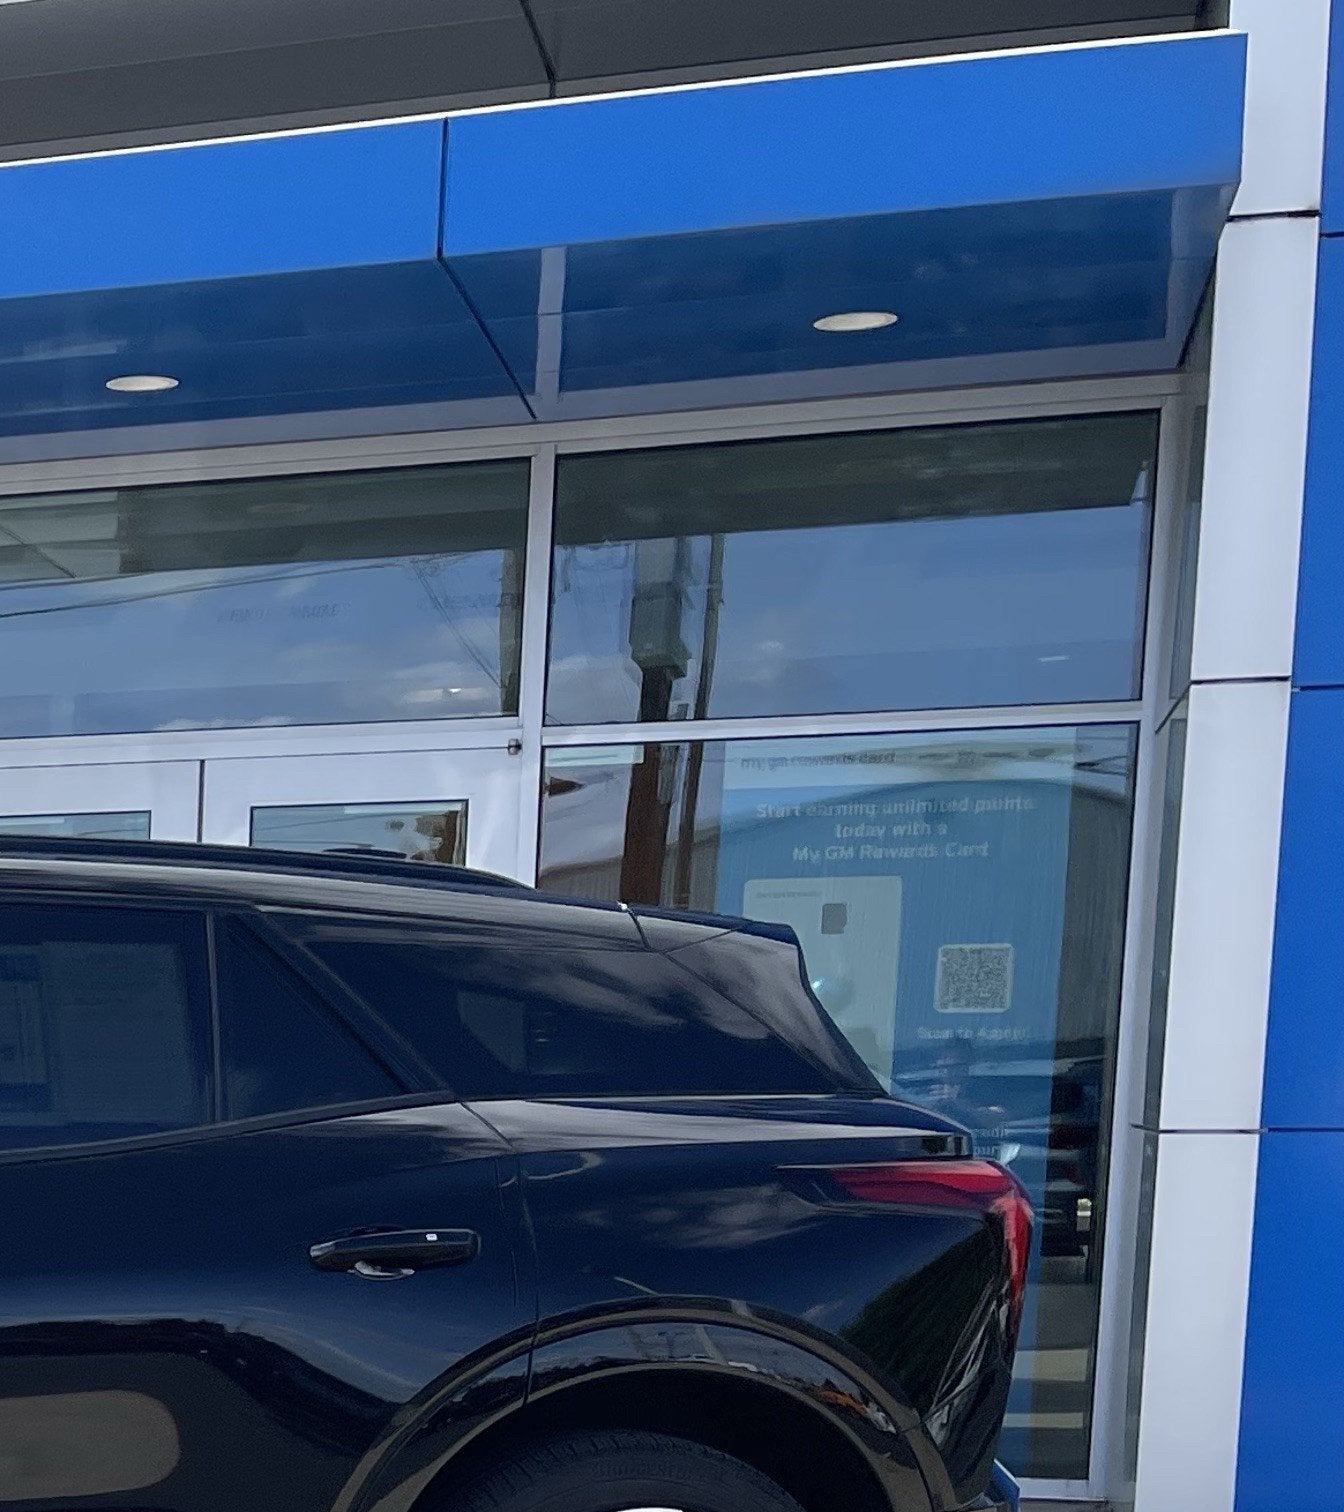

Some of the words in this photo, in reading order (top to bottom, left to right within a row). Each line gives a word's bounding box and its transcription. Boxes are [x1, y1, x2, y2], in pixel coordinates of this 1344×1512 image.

[756, 802, 801, 818] Start
[834, 823, 886, 840] today
[892, 822, 932, 837] with
[792, 846, 819, 863] My
[825, 845, 854, 861] GM
[860, 842, 940, 860] Rewards
[944, 840, 990, 857] Card
